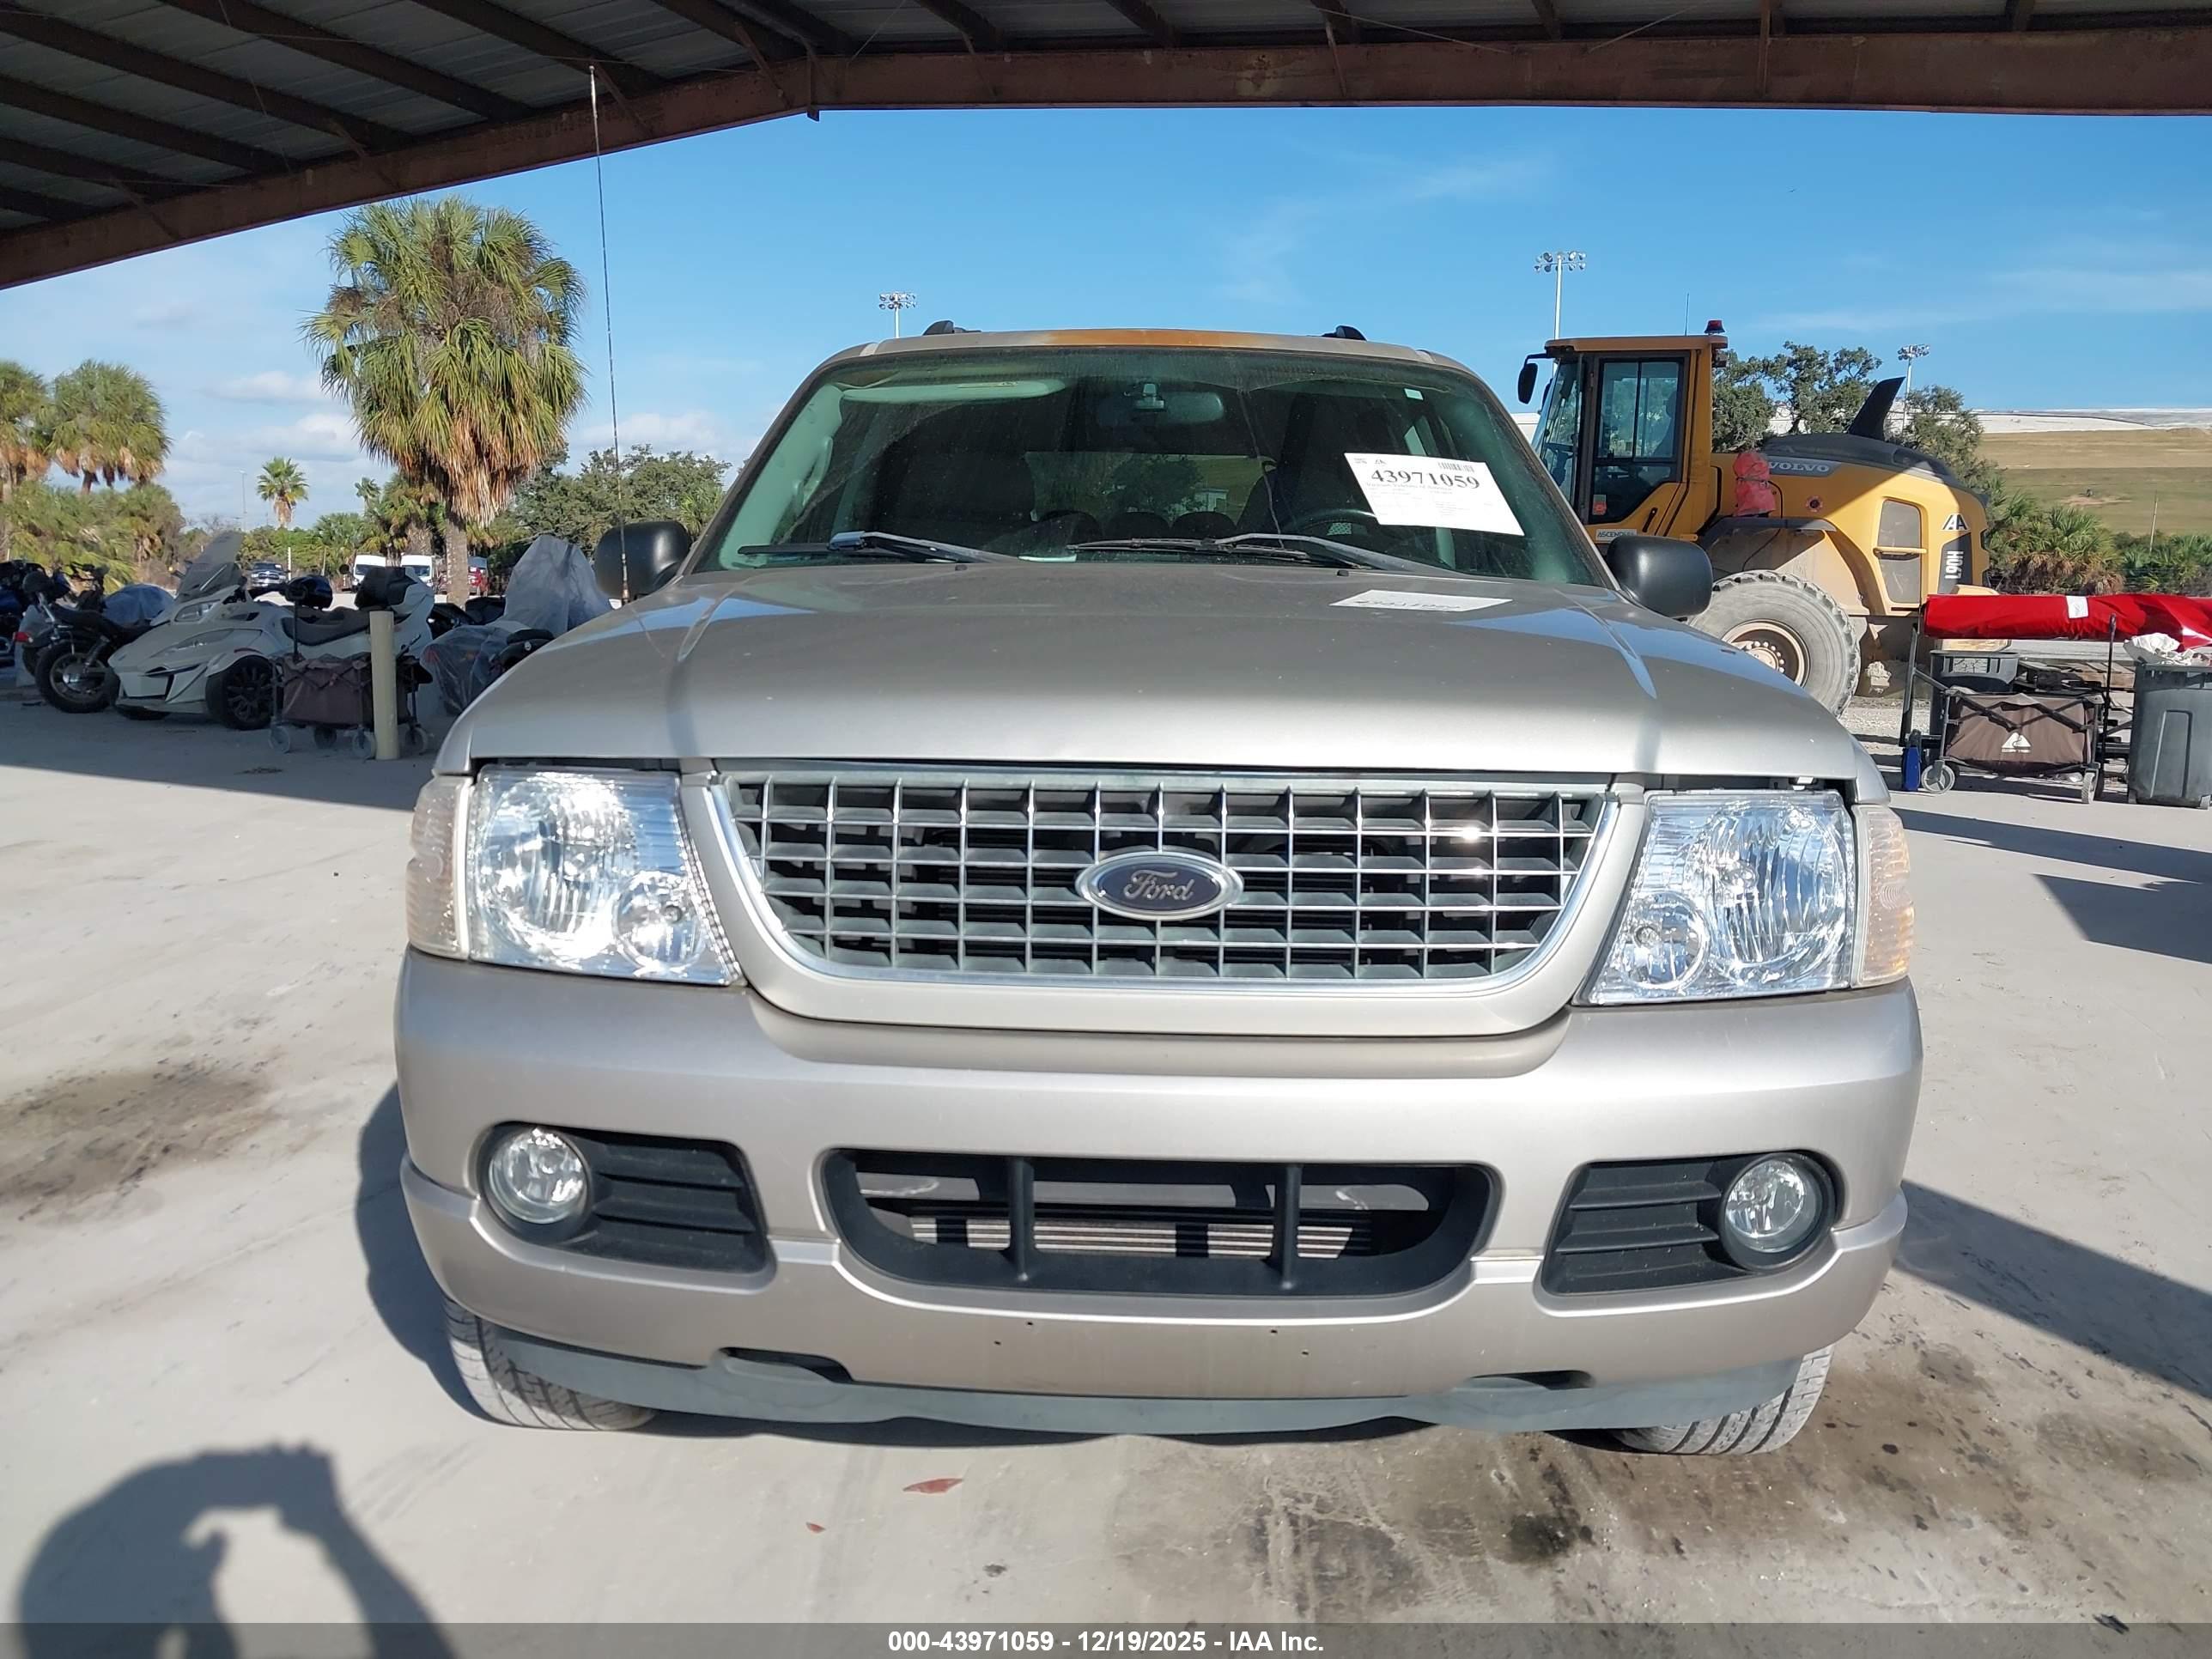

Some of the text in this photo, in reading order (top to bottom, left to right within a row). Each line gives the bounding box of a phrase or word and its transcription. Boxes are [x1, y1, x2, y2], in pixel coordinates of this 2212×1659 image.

[1371, 469, 1480, 489] 43971059
[1768, 461, 1830, 472] VOLVO
[1944, 550, 1964, 580] L90H
[1122, 869, 1195, 901] Ford
